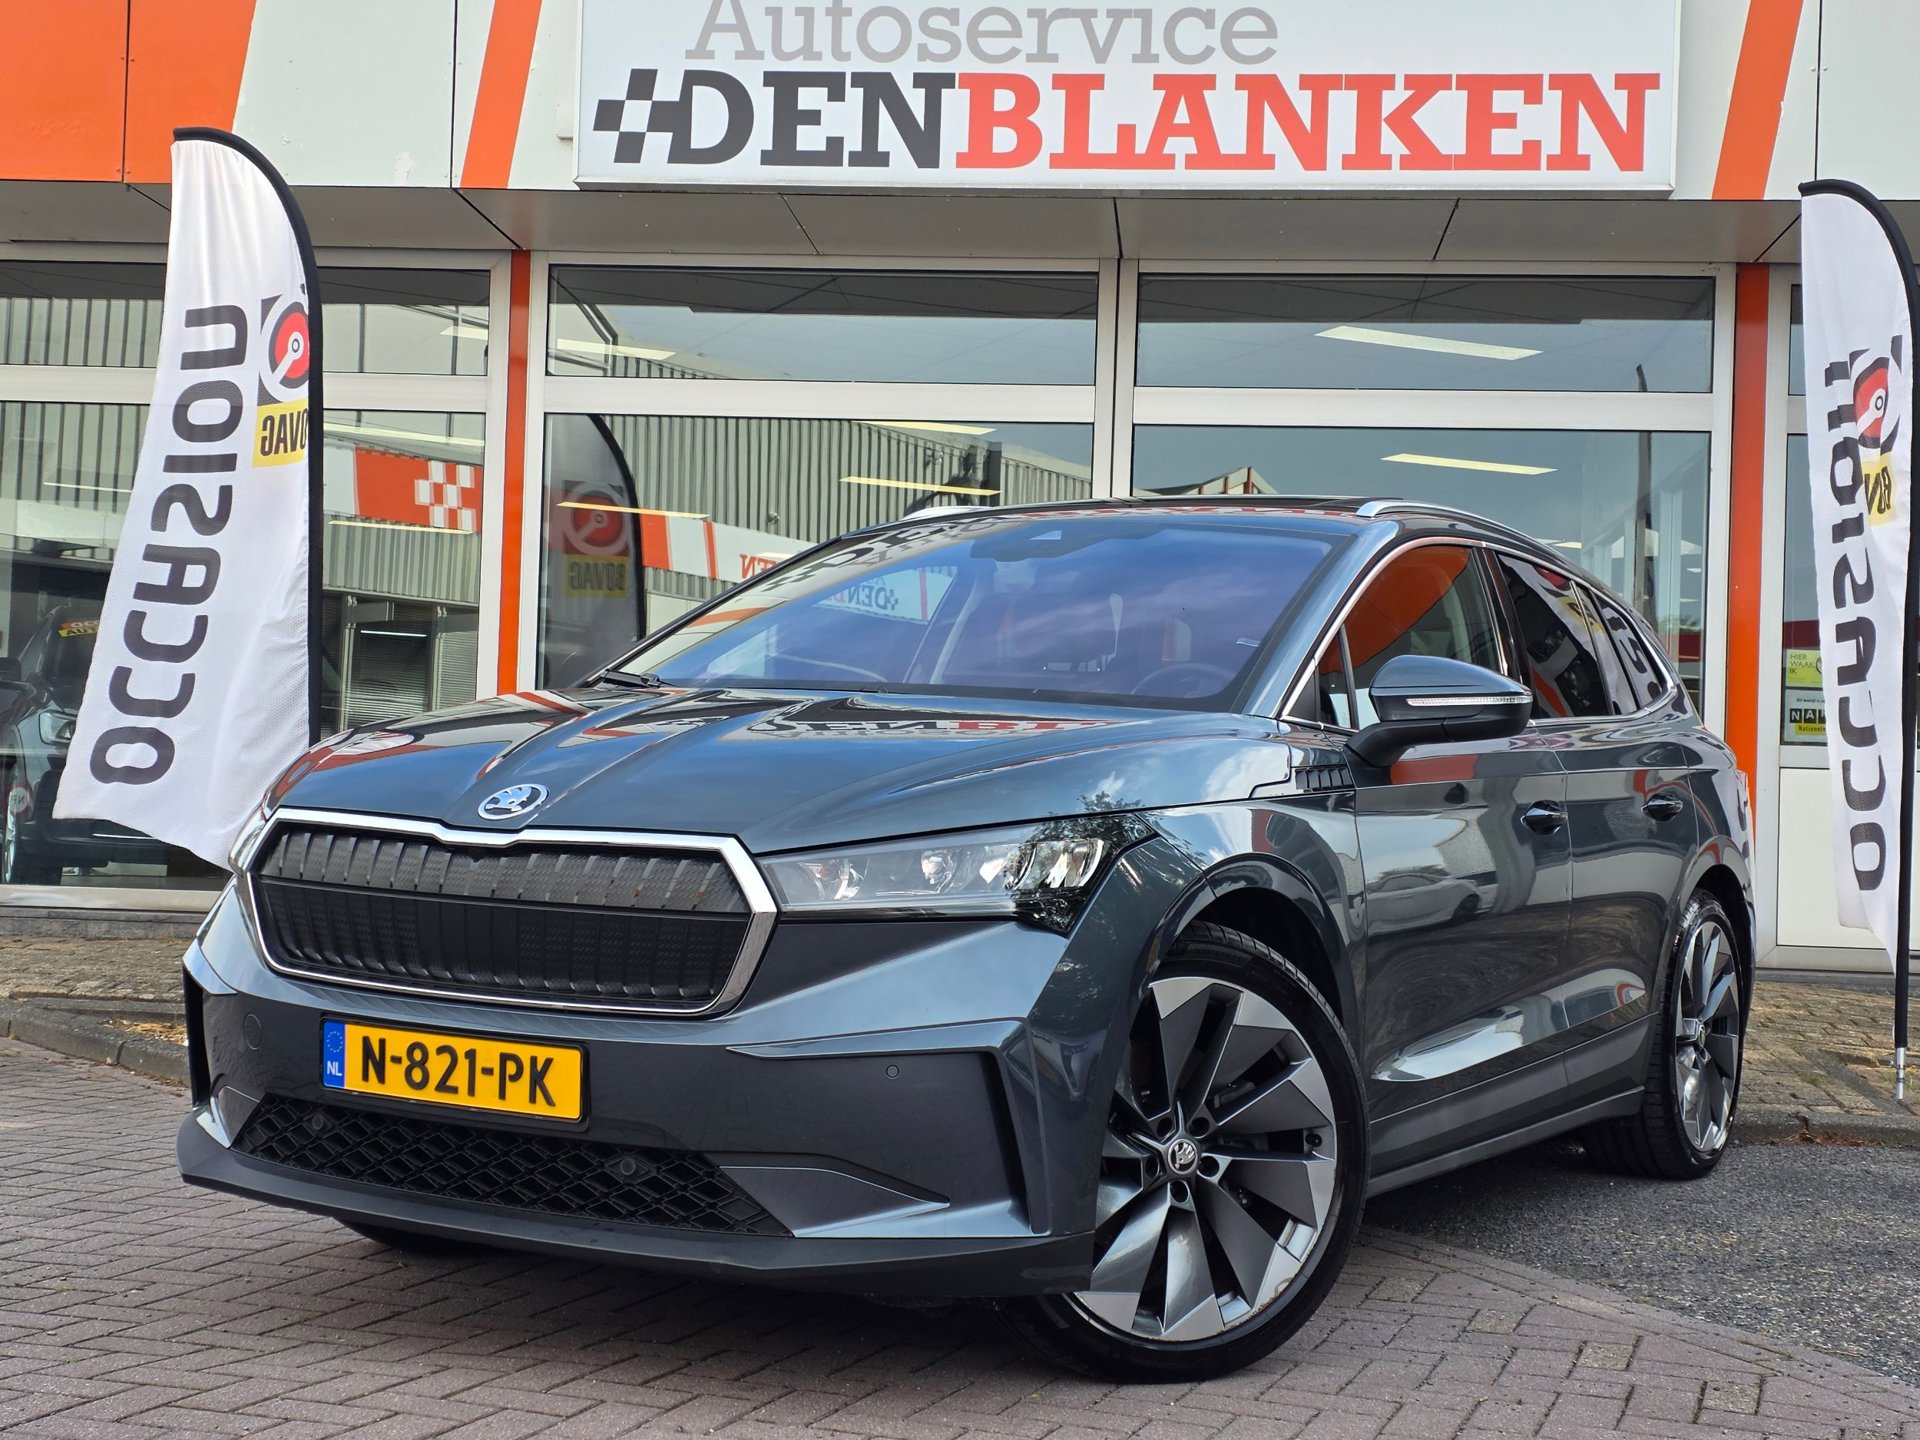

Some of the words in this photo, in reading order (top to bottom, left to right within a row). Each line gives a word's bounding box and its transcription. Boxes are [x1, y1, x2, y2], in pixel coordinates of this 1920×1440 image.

[685, 0, 1278, 64] Autoservice
[1790, 661, 1815, 669] WAAK
[327, 1060, 342, 1077] NL
[361, 1035, 556, 1107] N-821-PK
